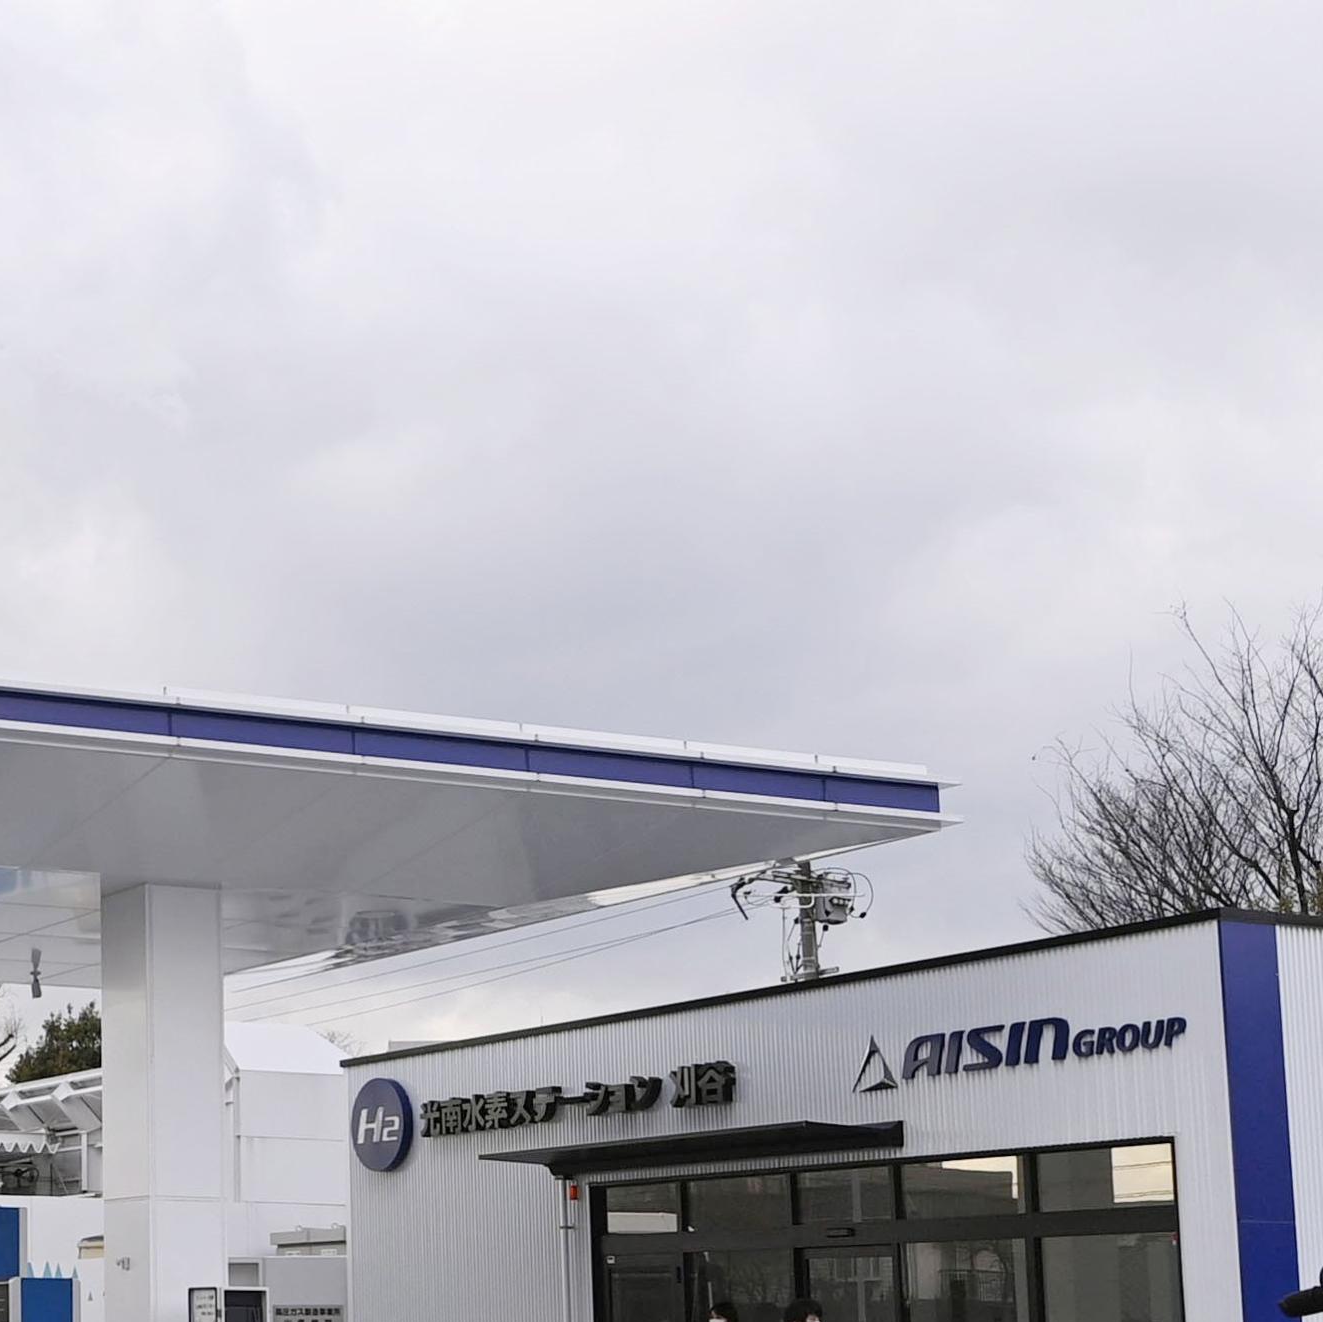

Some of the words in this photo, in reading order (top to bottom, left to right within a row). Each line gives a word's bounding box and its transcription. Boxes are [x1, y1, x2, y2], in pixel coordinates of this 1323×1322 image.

[901, 1016, 1070, 1080] AISIN
[1072, 1016, 1187, 1058] GROUP
[357, 1106, 401, 1145] H2
[420, 1076, 663, 1137] 光南水素ステーション
[670, 1061, 736, 1108] 刈谷
